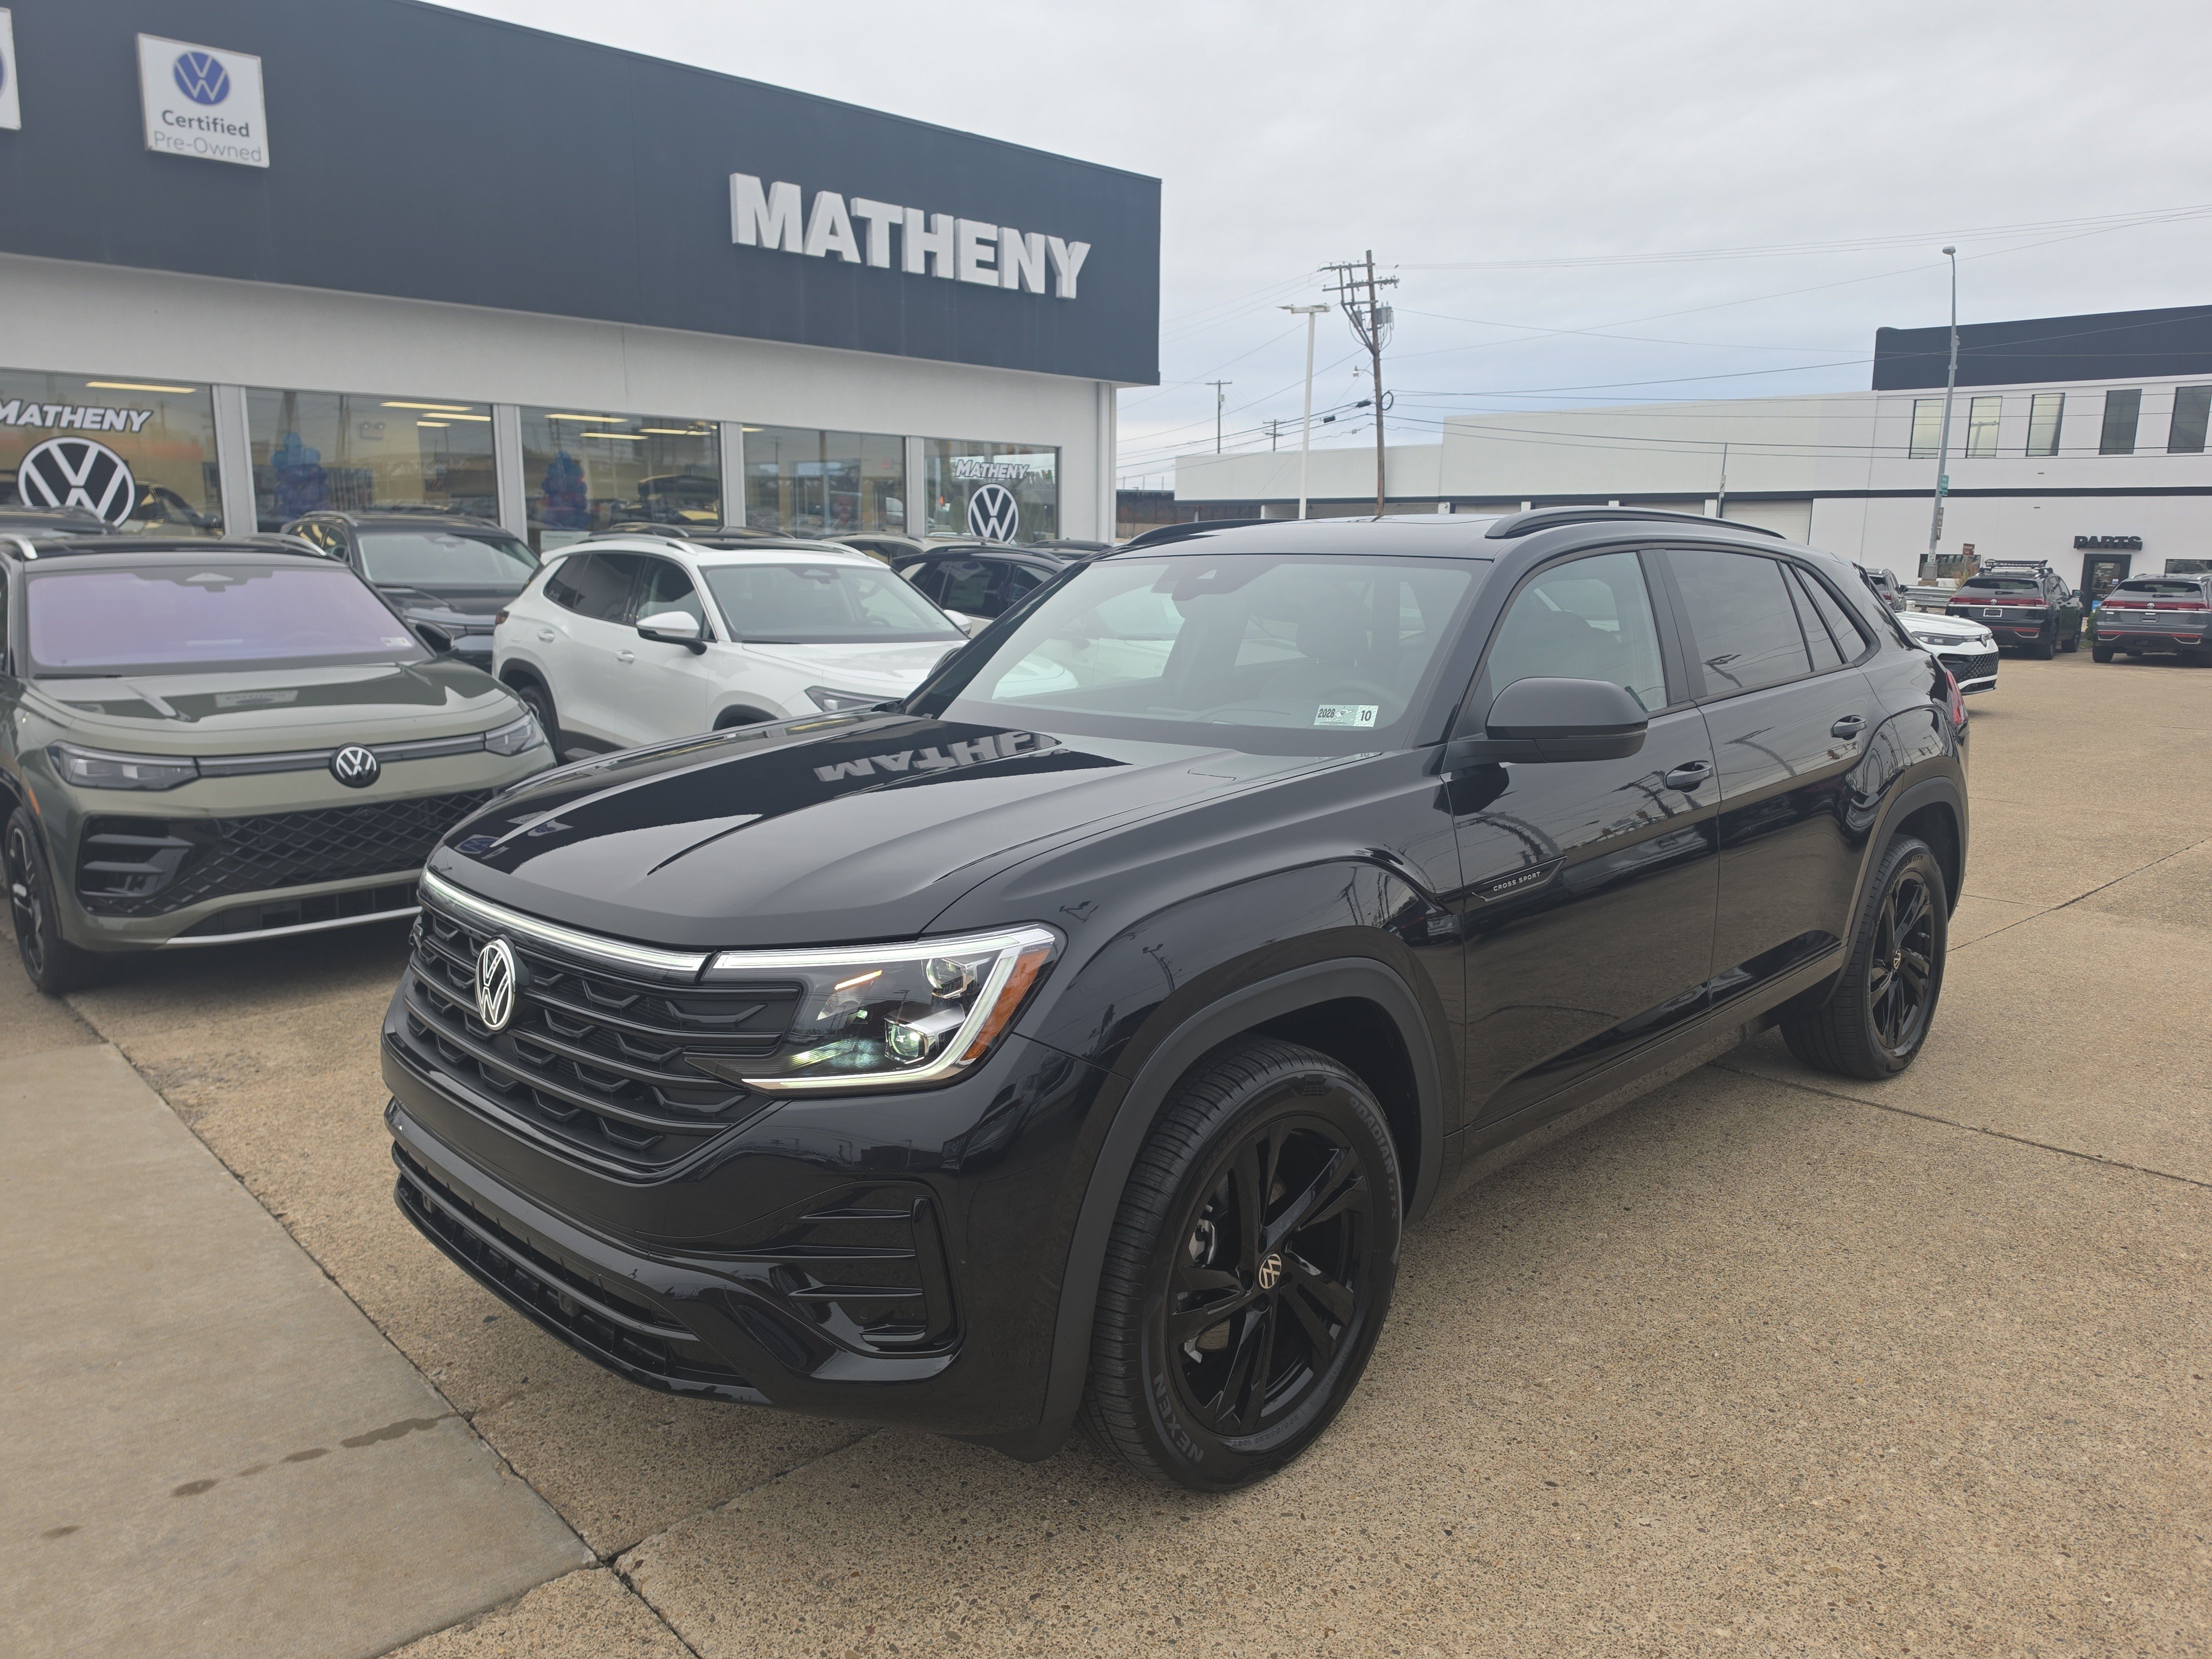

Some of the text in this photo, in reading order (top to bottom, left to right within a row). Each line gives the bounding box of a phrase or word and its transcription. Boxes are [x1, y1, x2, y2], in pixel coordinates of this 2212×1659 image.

[162, 109, 250, 138] Certified
[152, 130, 262, 163] Pre-Owned
[729, 172, 1091, 299] MATHENY
[0, 399, 152, 433] MATHENY
[955, 459, 1030, 480] MATHENY
[2074, 536, 2143, 550] PARTS
[1317, 708, 1336, 718] 2028
[1360, 710, 1372, 722] 10
[1493, 871, 1541, 891] CROSS SPORT
[1388, 1178, 1398, 1220] GTX
[1154, 1372, 1205, 1463] NEXEN
